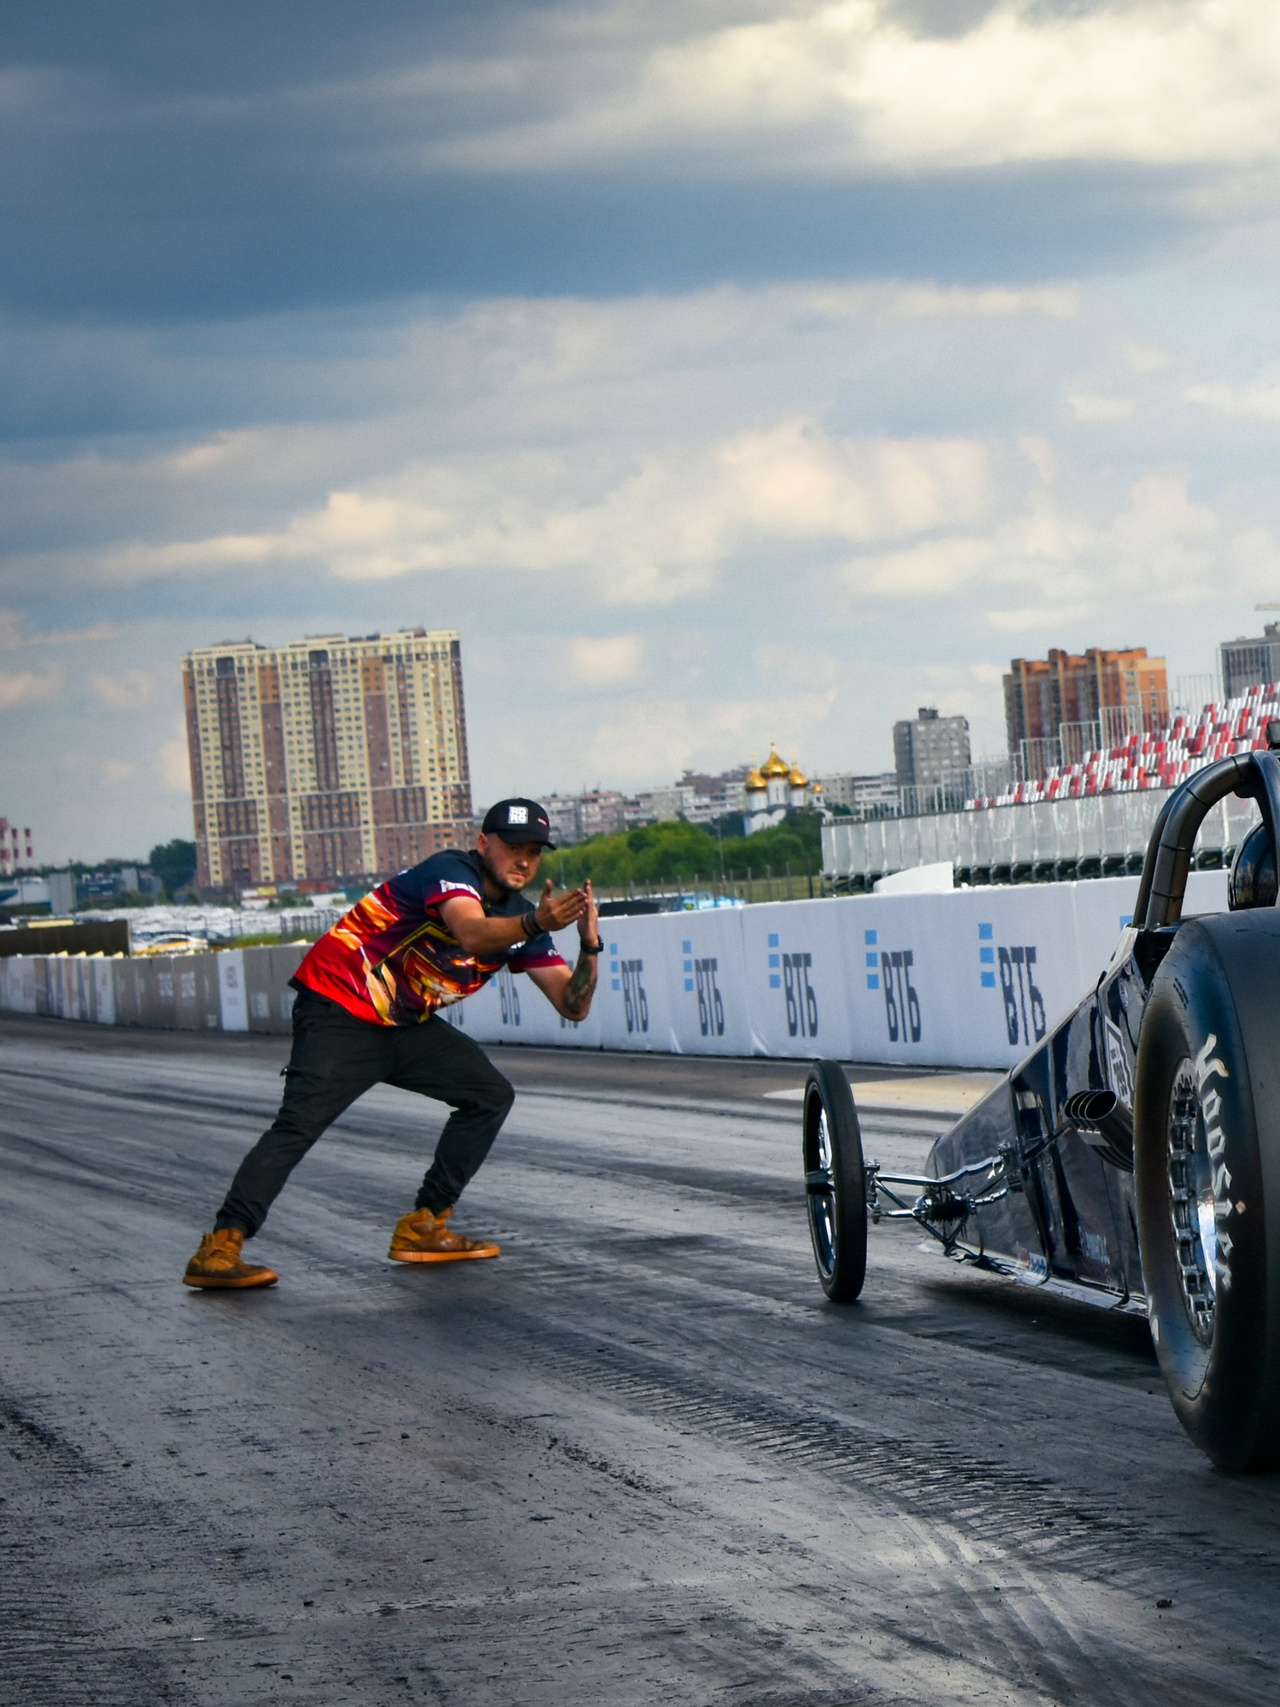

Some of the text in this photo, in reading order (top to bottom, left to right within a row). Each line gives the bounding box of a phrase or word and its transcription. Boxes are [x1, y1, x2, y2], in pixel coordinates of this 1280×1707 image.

[621, 959, 648, 1033] ВТБ
[695, 958, 724, 1037] ВТБ
[783, 953, 818, 1038] ВТБ
[881, 950, 921, 1043] ВТБ
[998, 946, 1046, 1047] ВТБ
